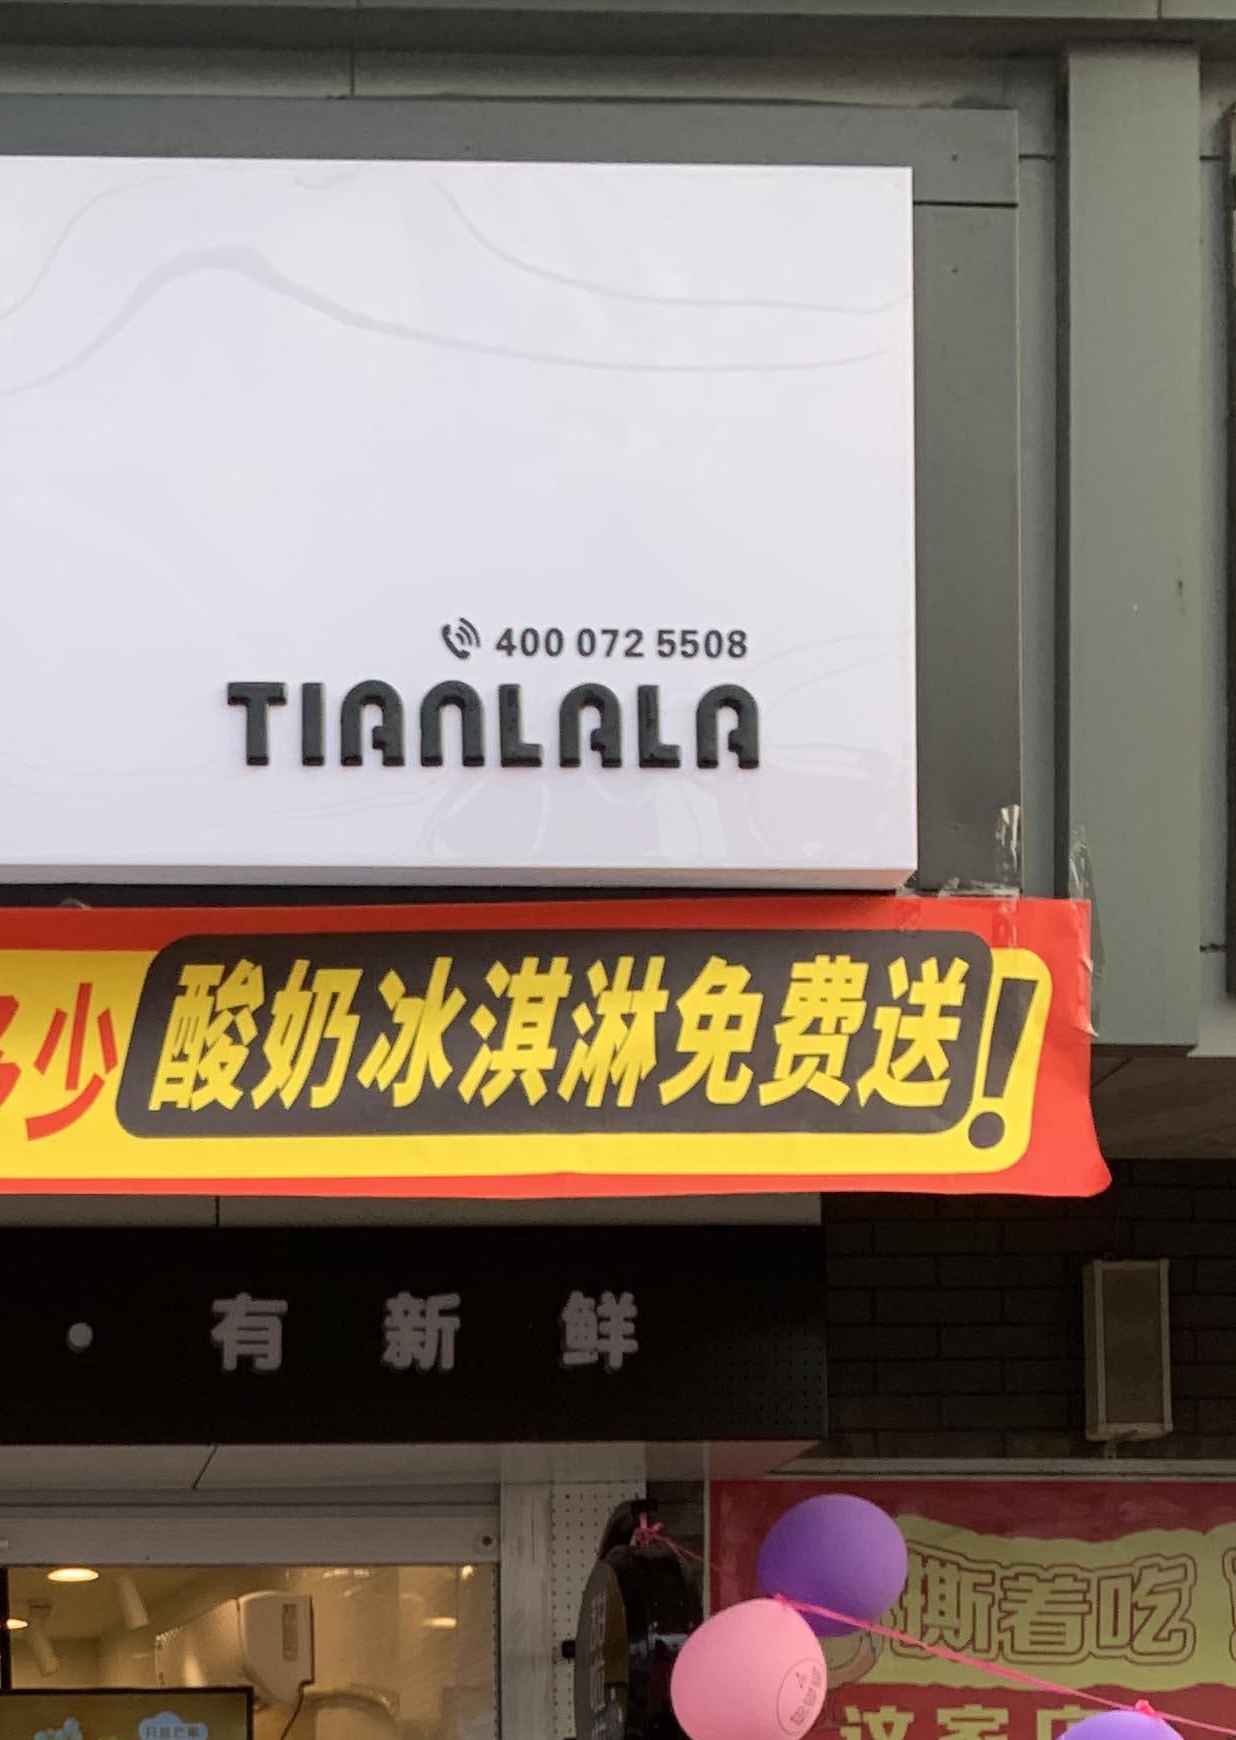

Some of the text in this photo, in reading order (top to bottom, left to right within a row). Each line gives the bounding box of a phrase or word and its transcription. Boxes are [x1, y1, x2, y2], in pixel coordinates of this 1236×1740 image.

[495, 626, 749, 662] 400 072 5508
[227, 678, 761, 771] TIANLALA
[882, 1548, 1194, 1662] 撕着吃
